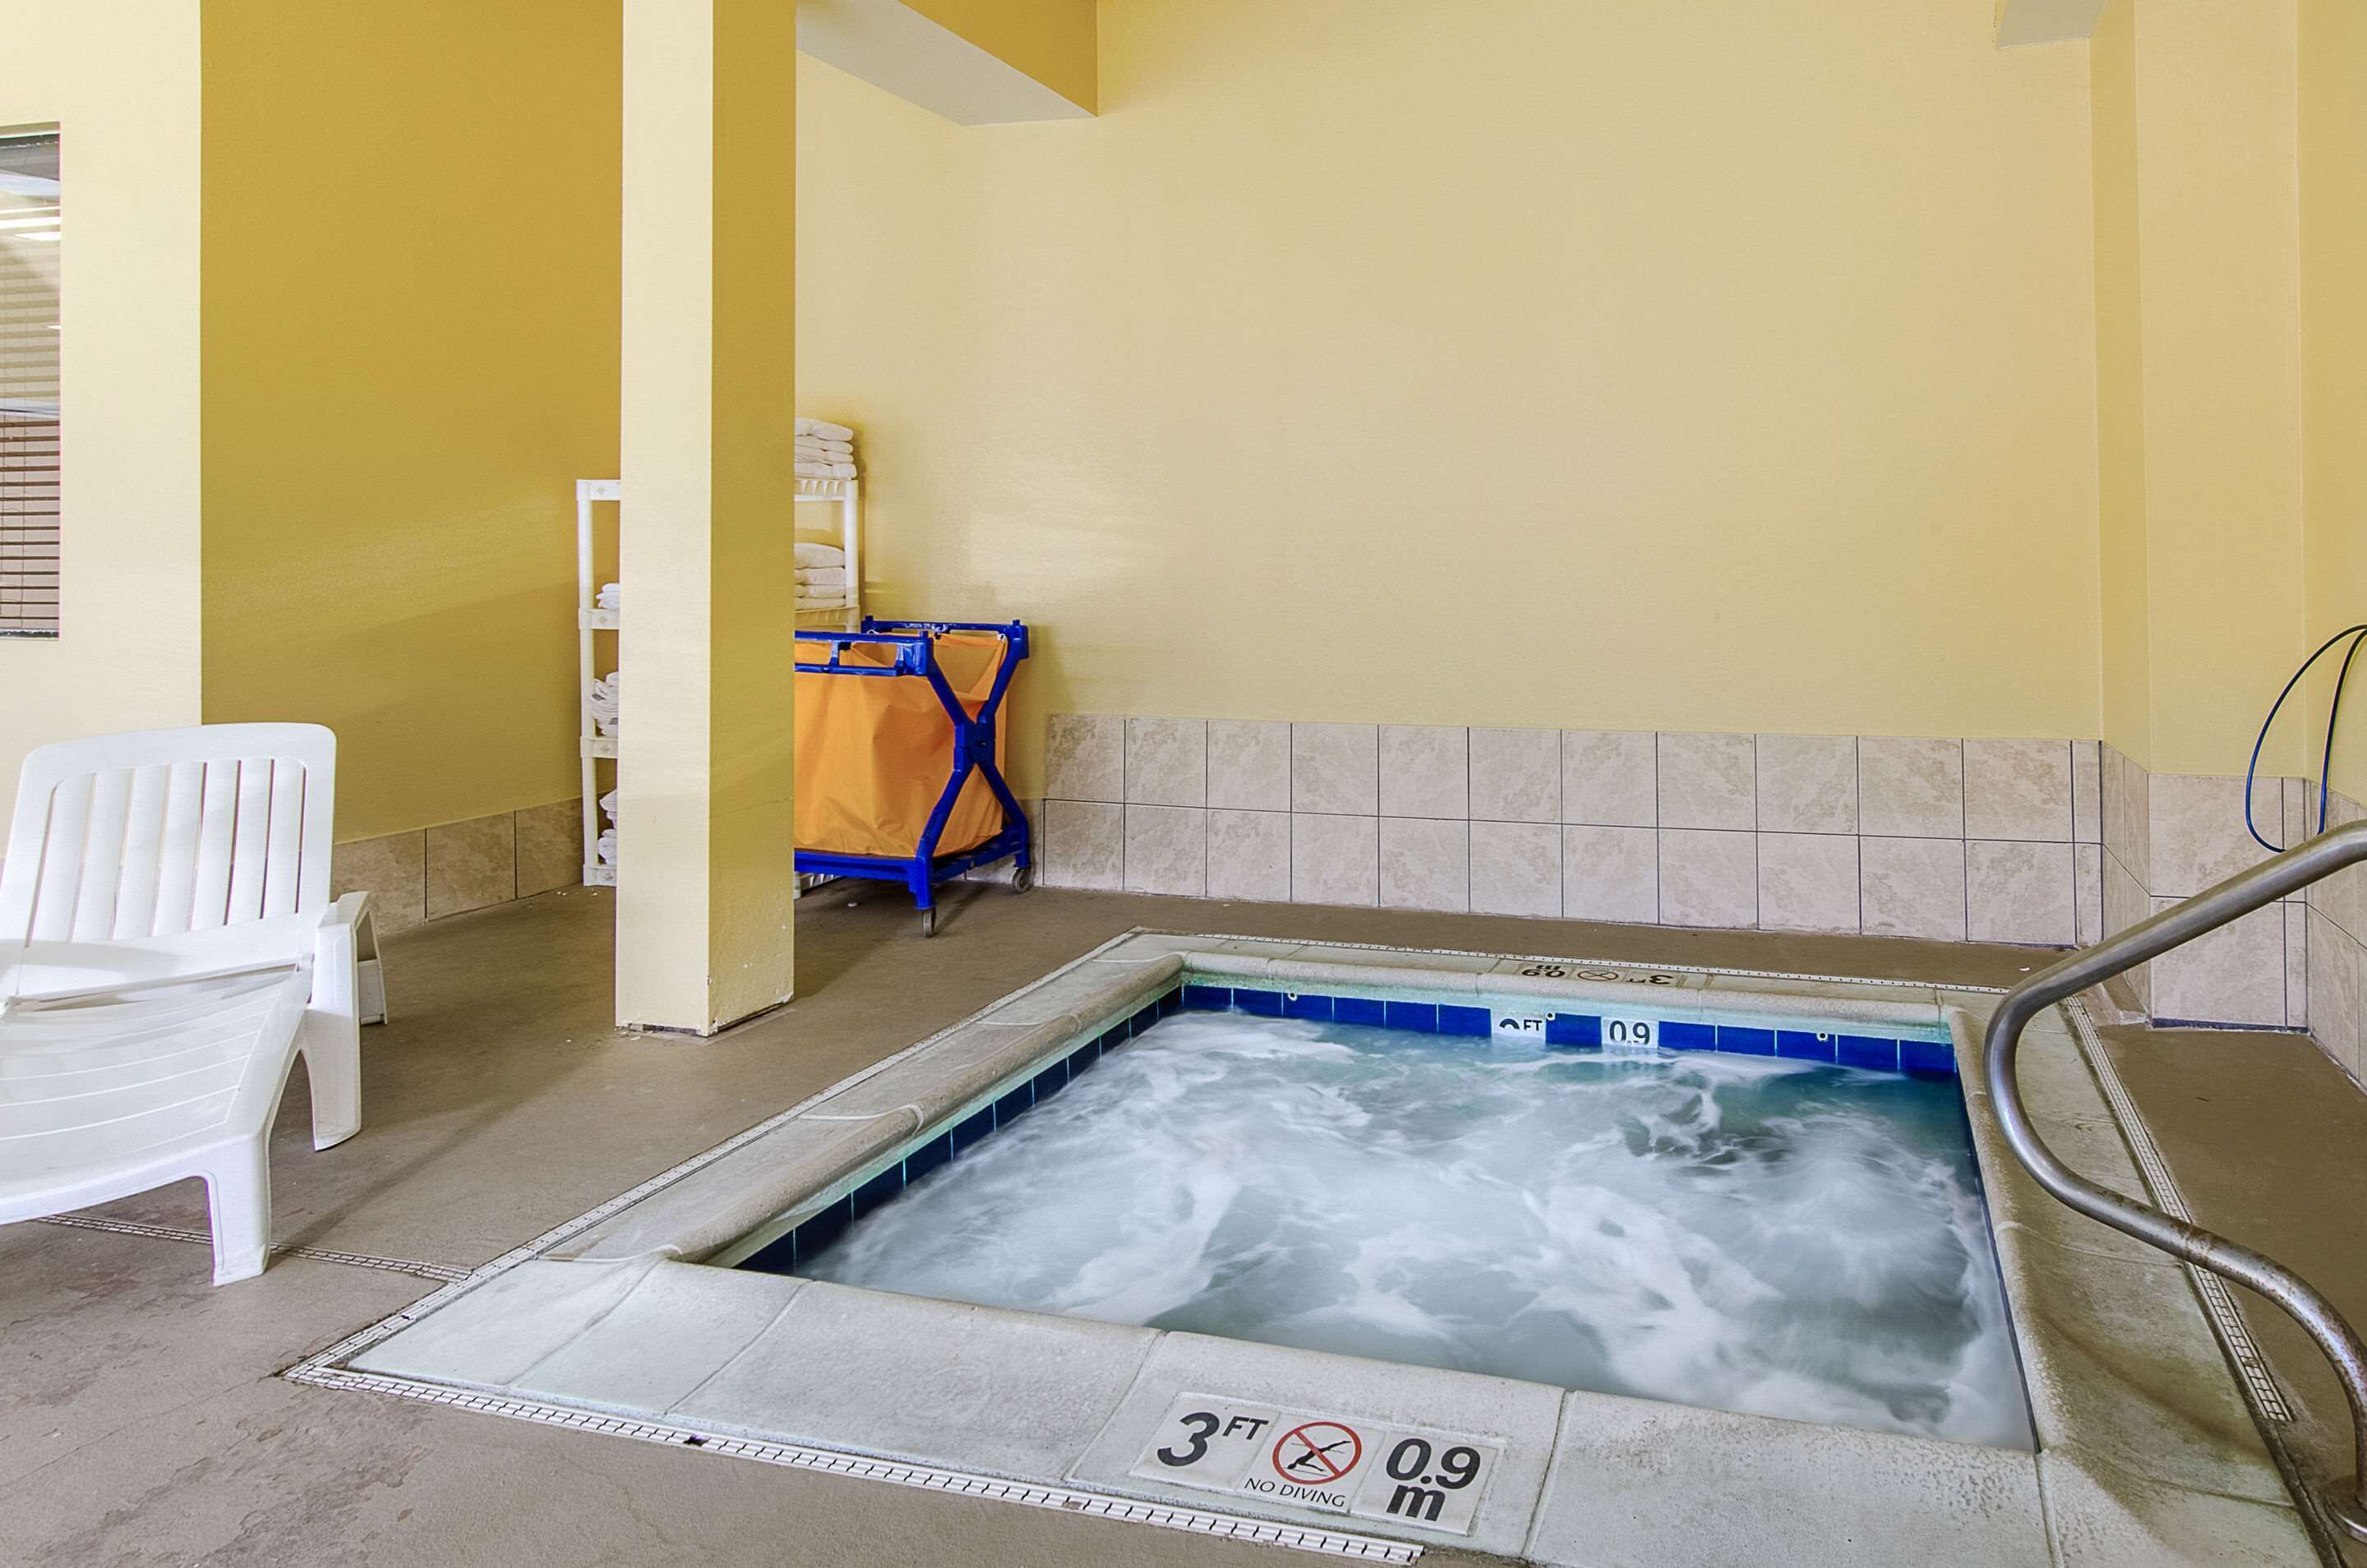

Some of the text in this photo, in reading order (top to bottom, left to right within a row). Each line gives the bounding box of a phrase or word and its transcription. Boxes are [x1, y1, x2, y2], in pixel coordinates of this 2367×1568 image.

[1650, 975, 1674, 985] 3
[1523, 1018, 1543, 1031] FT
[1156, 1411, 1269, 1467] 3 FT
[1386, 1437, 1481, 1490] 0.9
[1244, 1478, 1346, 1507] NO DIVING
[1386, 1483, 1446, 1522] m
